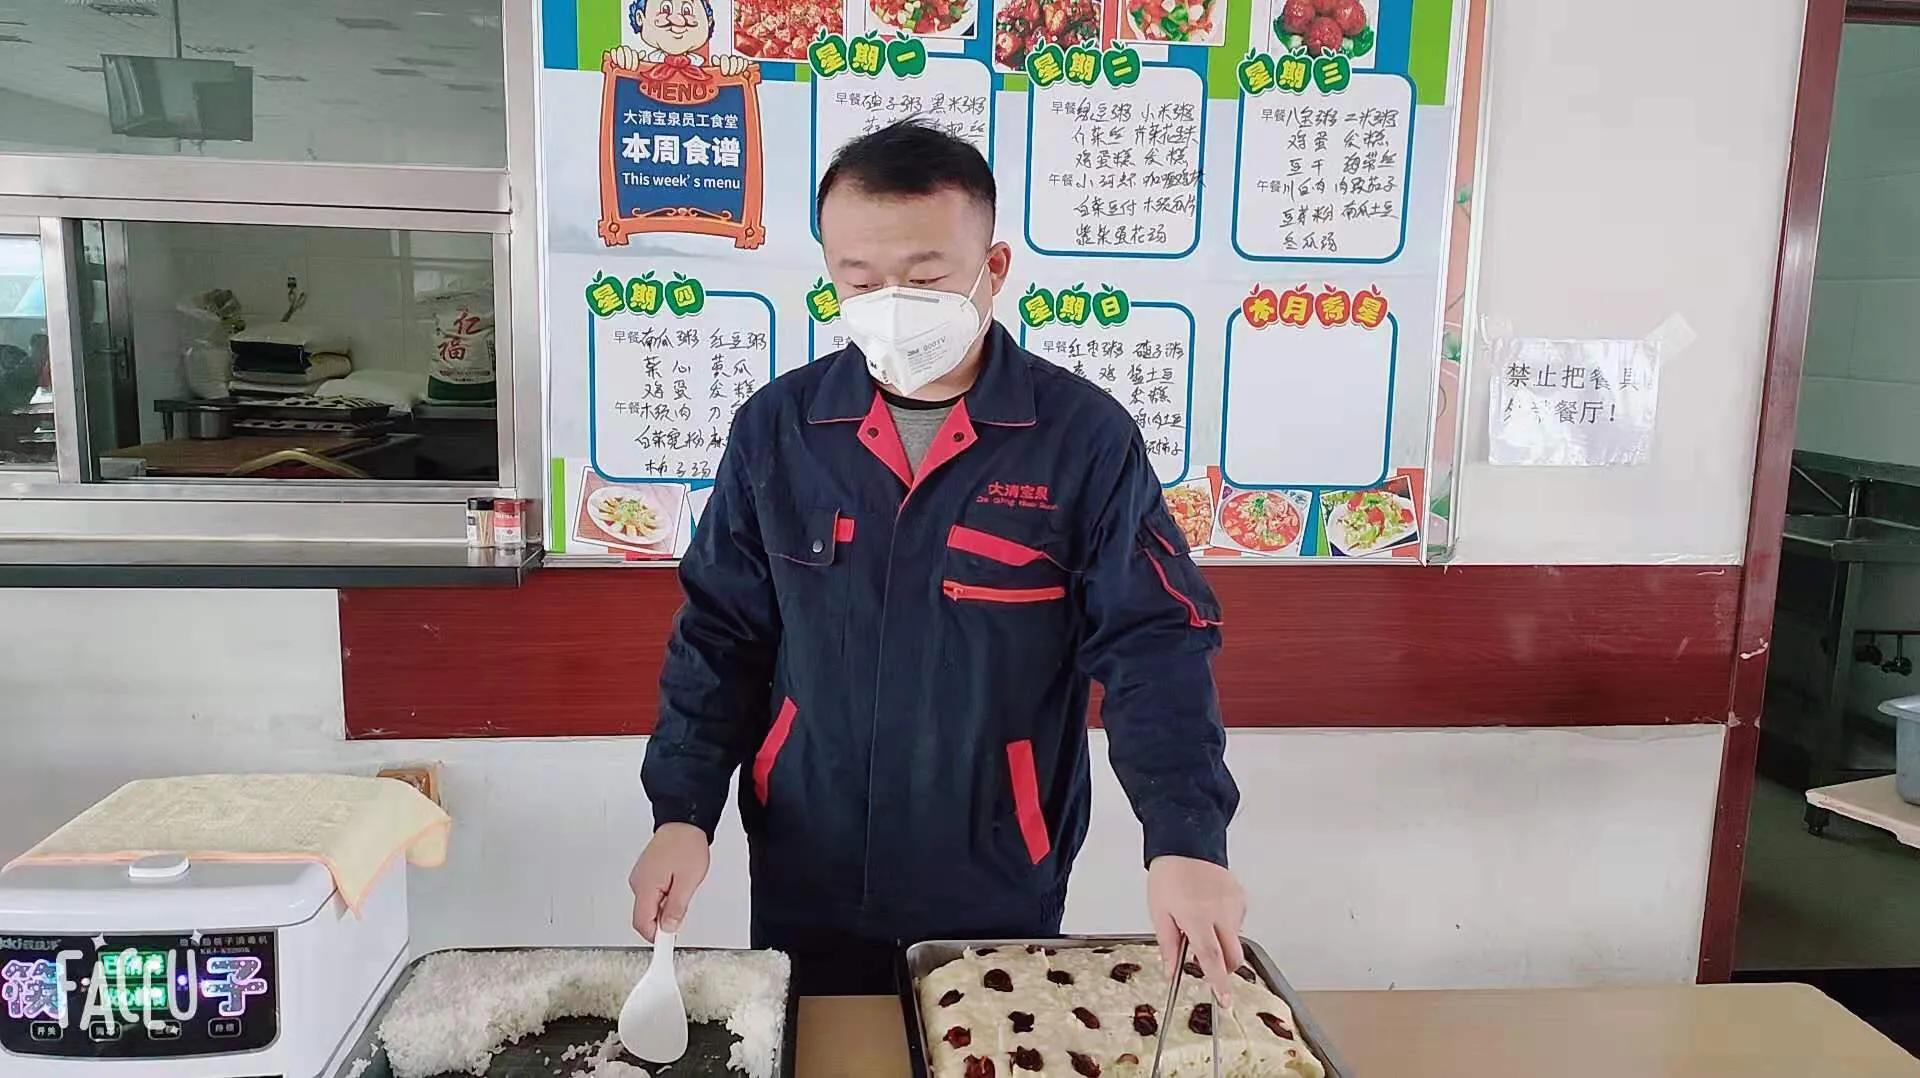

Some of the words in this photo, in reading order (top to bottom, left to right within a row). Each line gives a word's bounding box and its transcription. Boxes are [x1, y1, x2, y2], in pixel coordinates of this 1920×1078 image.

[816, 42, 916, 74] 星期一
[1033, 51, 1132, 84] 星期二
[1245, 60, 1343, 92] 星期三
[648, 83, 708, 101] MENU
[835, 92, 861, 106] 早餐
[930, 93, 987, 115] 黑米粥
[1051, 101, 1076, 115] 早餐
[1141, 103, 1195, 122] 小米粥
[1261, 108, 1286, 122] 早餐
[623, 109, 739, 129] 大清宝泉员工食堂
[1285, 106, 1338, 128] 八宝粥
[1344, 107, 1399, 128] 二米粥
[621, 132, 741, 168] 本周食谱
[1287, 129, 1328, 152] 鸡蛋
[1344, 129, 1389, 149] 发糕
[1075, 147, 1135, 169] 鸡蛋糕
[1143, 147, 1189, 169] 发糕
[622, 172, 651, 186] This
[704, 178, 740, 189] menu
[1048, 173, 1073, 187] 午餐
[1256, 180, 1281, 193] 午餐
[1341, 199, 1399, 222] 南瓜土豆
[1075, 223, 1168, 246] 紫菜蛋花汤
[593, 283, 696, 314] 星期四
[813, 289, 840, 319] 星
[1025, 295, 1121, 324] 星期日
[1249, 295, 1381, 323] 本月寿星
[613, 330, 640, 343] 早餐
[639, 327, 700, 353] 南瓜粥
[709, 327, 767, 351] 红豆粥
[1043, 340, 1067, 353] 早餐
[1068, 338, 1124, 358] 红枣粥
[643, 355, 691, 380] 菜心
[711, 353, 753, 378] 黄瓜
[642, 379, 692, 401] 鸡蛋
[614, 401, 640, 414] 午餐
[201, 956, 268, 1016] 子
